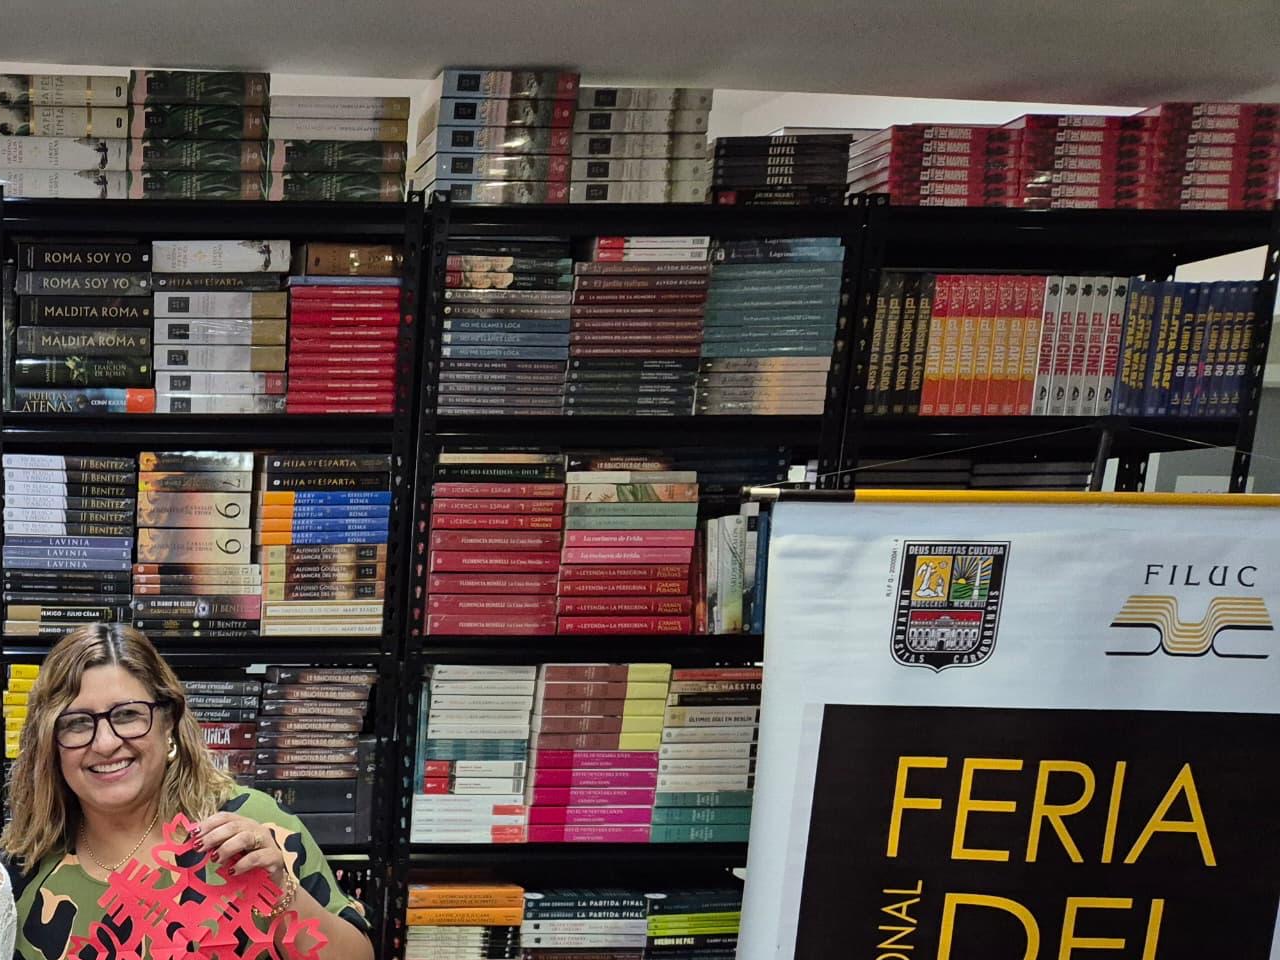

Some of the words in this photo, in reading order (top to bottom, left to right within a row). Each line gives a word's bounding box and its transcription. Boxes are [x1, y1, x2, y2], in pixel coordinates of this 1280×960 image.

[44, 253, 82, 264] ROMA
[86, 252, 111, 264] SOY
[113, 252, 132, 263] YO
[44, 305, 99, 318] MALDITA
[100, 306, 138, 318] ROMA
[22, 400, 73, 413] ATENAS
[48, 538, 91, 547] LAVINIA
[909, 545, 929, 555] DEUS
[931, 545, 966, 555] LIBERTAS
[968, 545, 1004, 555] CULTURA
[1145, 563, 1258, 588] FILUC
[885, 754, 1218, 867] FERIA
